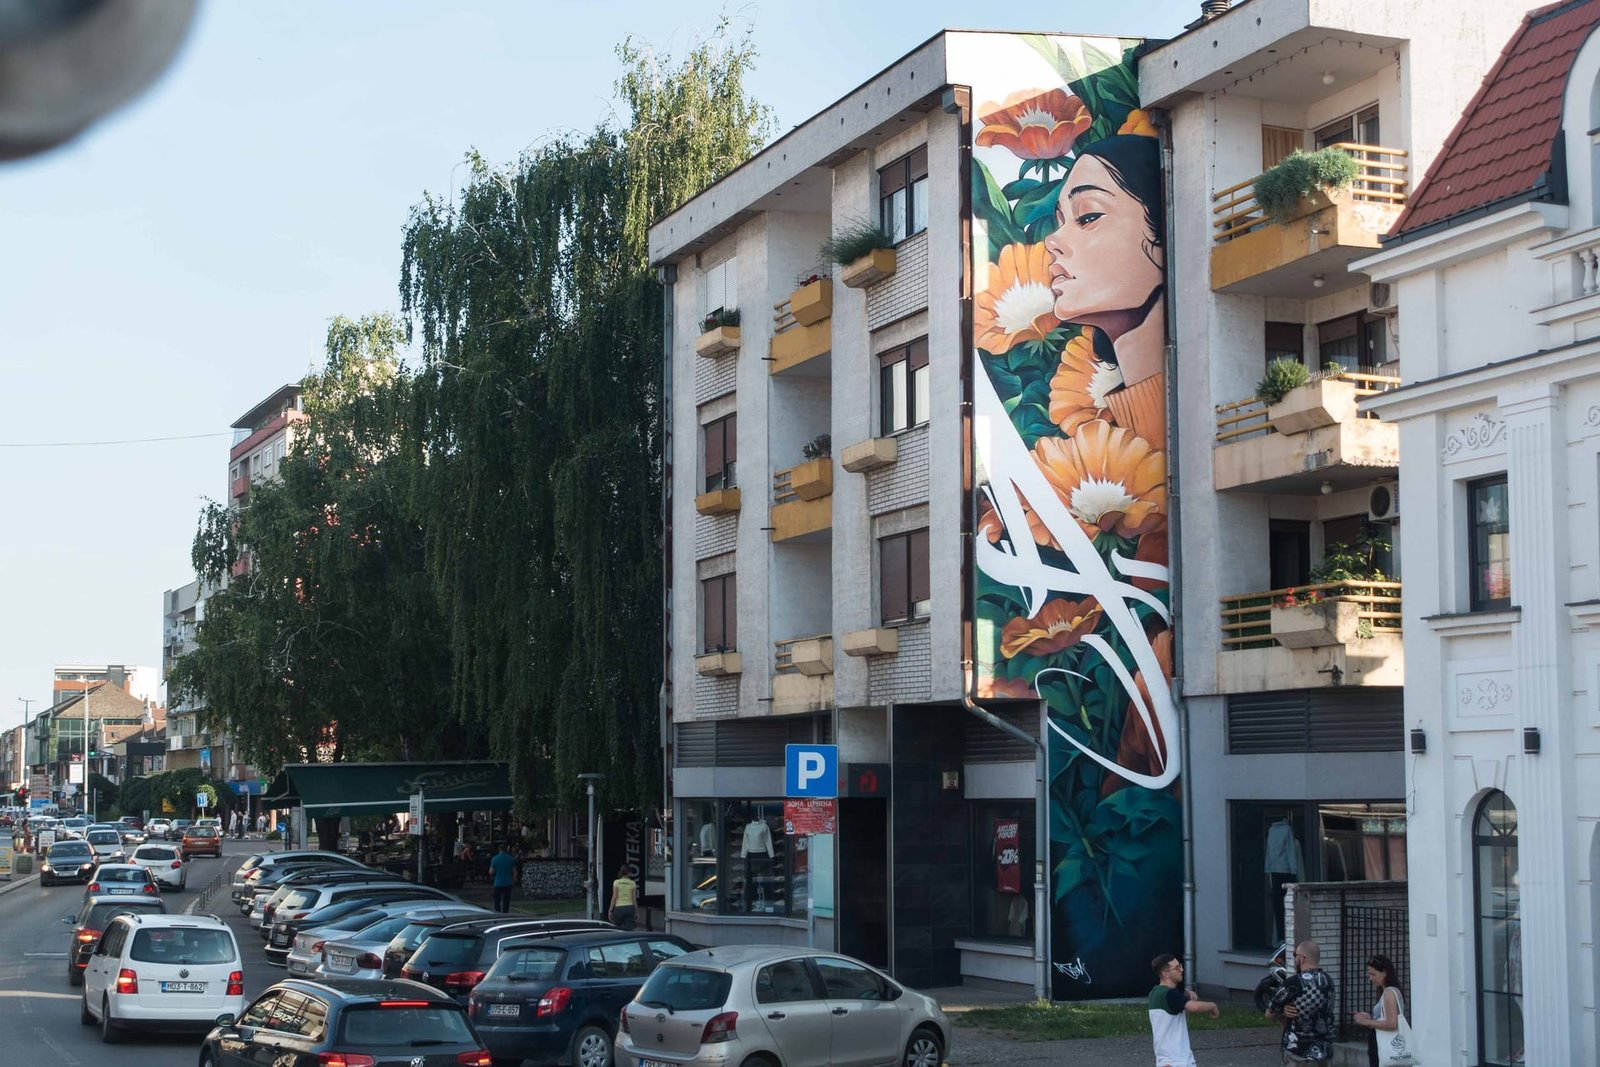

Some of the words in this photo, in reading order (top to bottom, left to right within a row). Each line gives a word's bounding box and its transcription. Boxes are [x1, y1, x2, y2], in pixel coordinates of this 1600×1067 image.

[798, 752, 825, 789] P
[998, 831, 1017, 839] POPUST
[998, 848, 1019, 865] -20%
